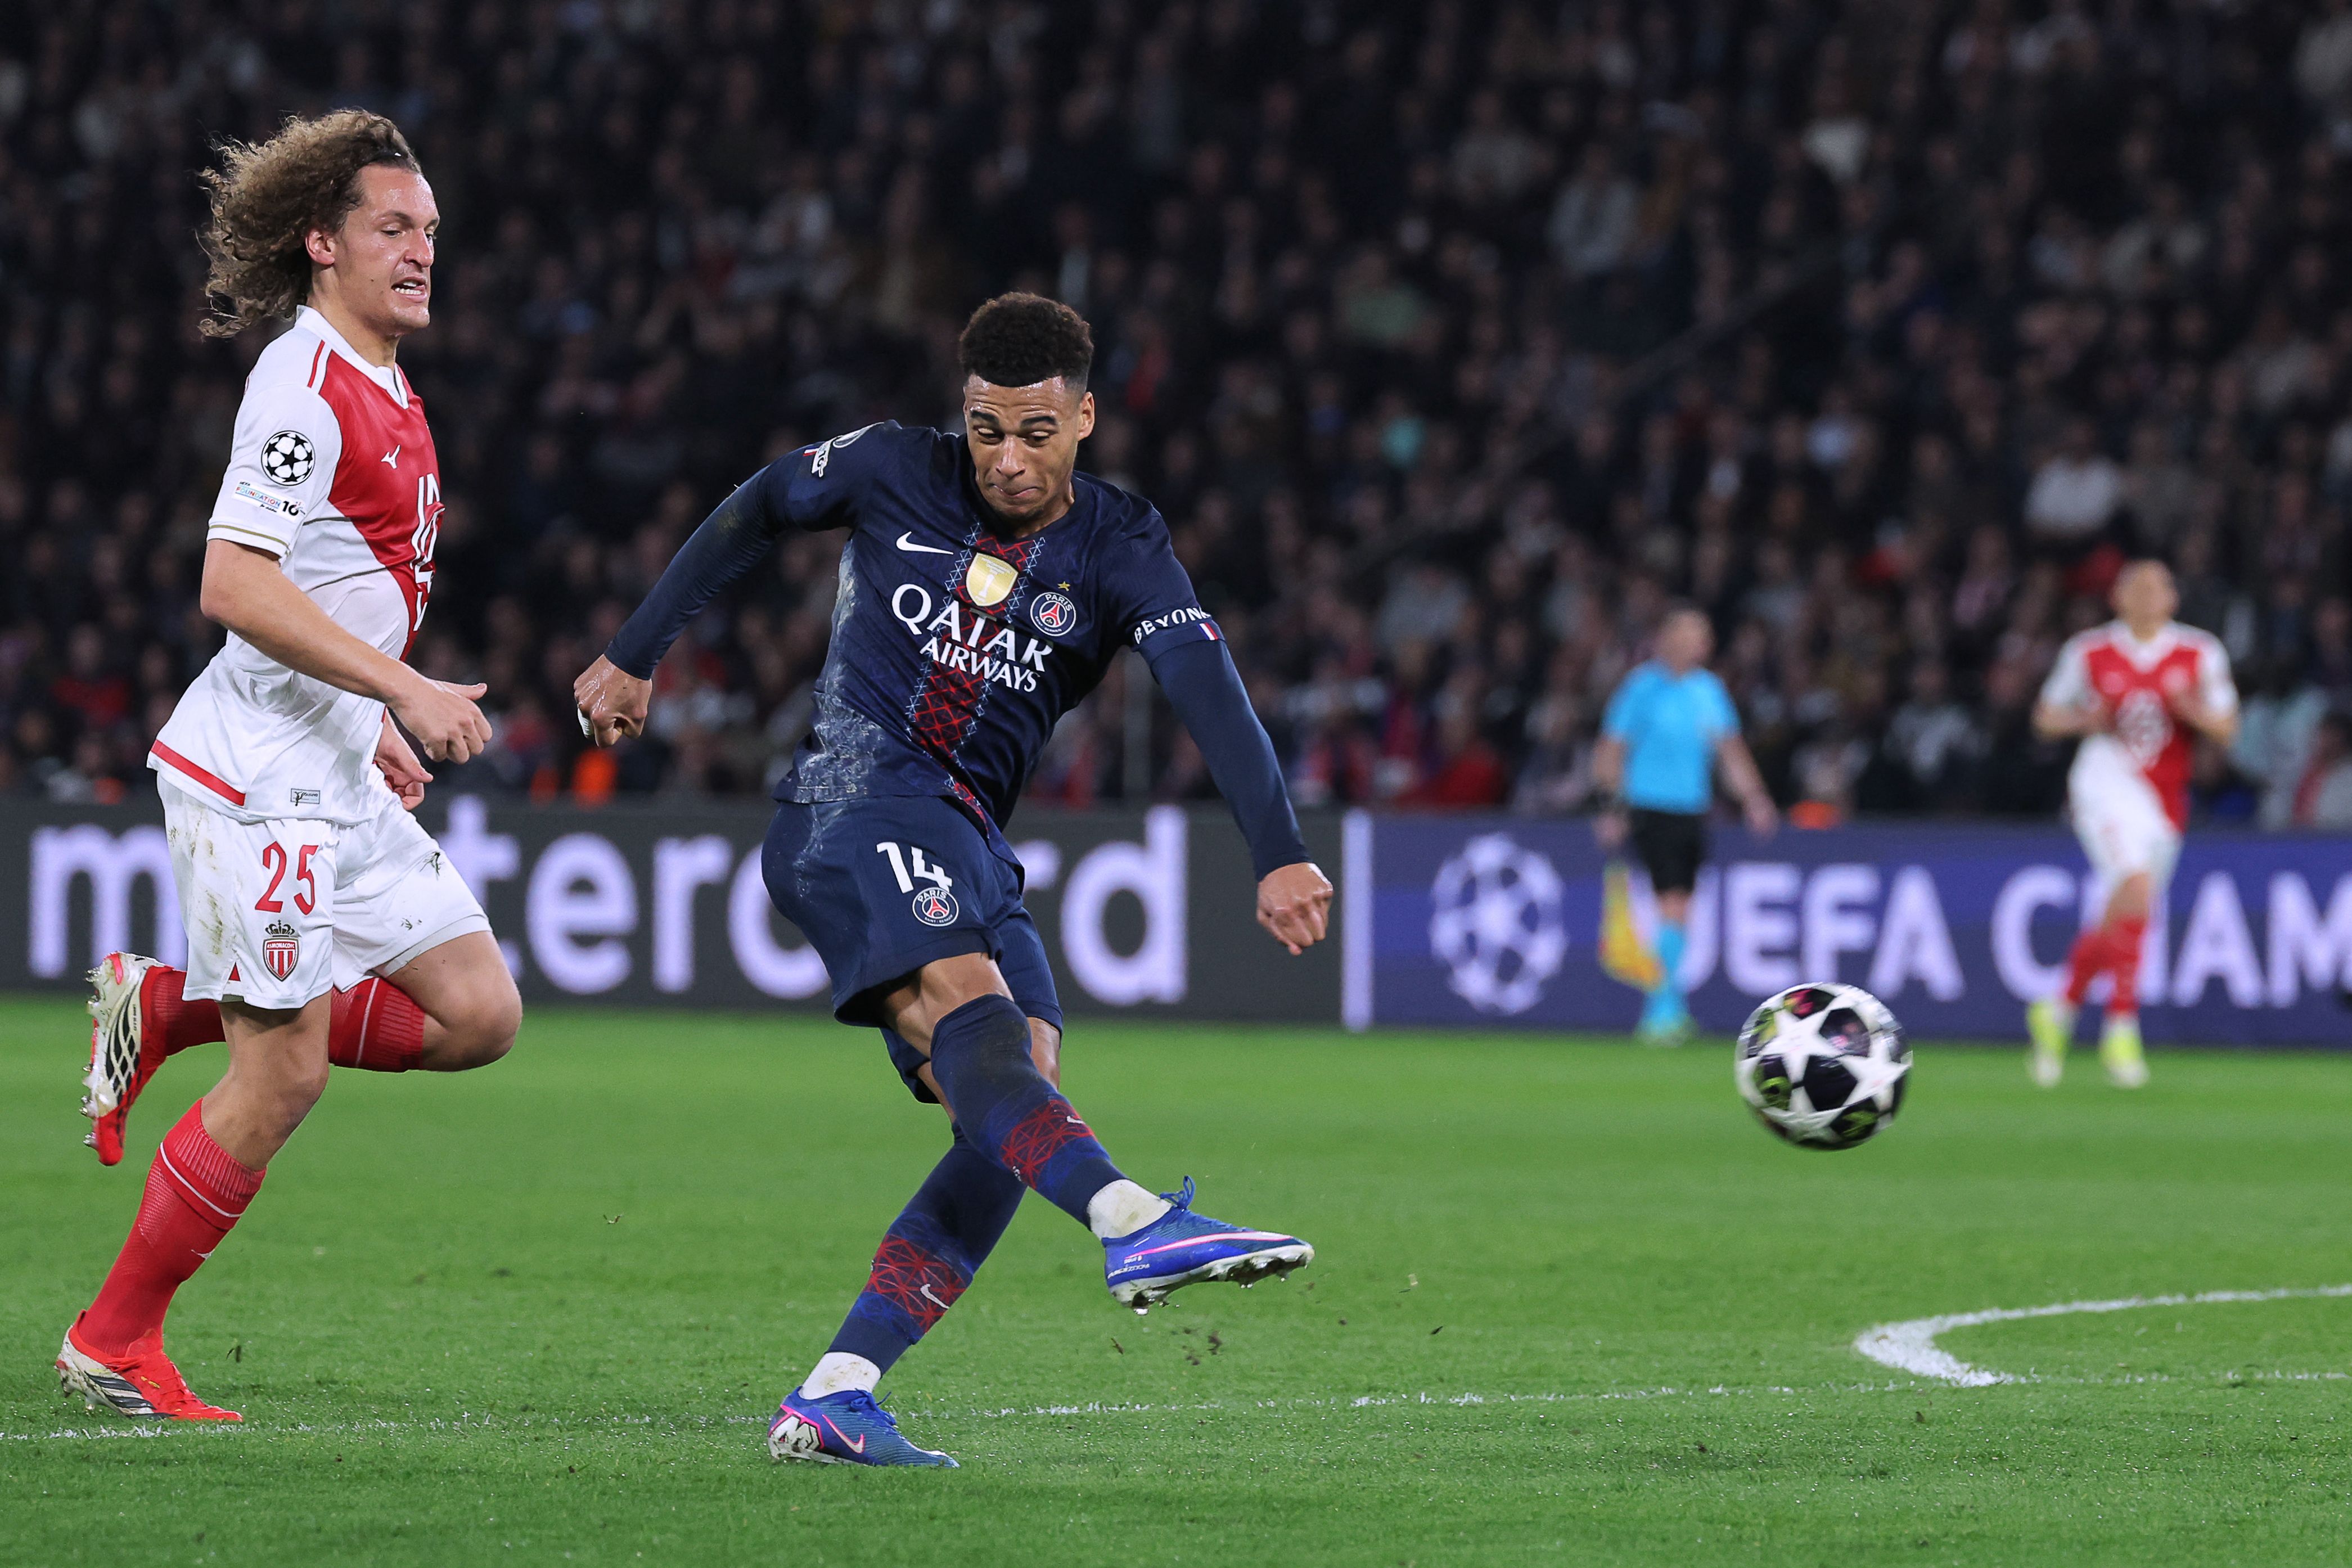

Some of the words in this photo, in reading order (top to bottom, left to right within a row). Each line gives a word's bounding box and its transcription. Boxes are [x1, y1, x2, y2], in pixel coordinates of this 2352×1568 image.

[236, 486, 281, 507] FOUNDATION
[891, 583, 1053, 672] QATAR
[1045, 594, 1072, 611] PARIS
[920, 637, 1040, 692] AIRWAYS
[255, 841, 319, 915] 25
[876, 842, 952, 894] 14
[917, 890, 947, 902] PARIS
